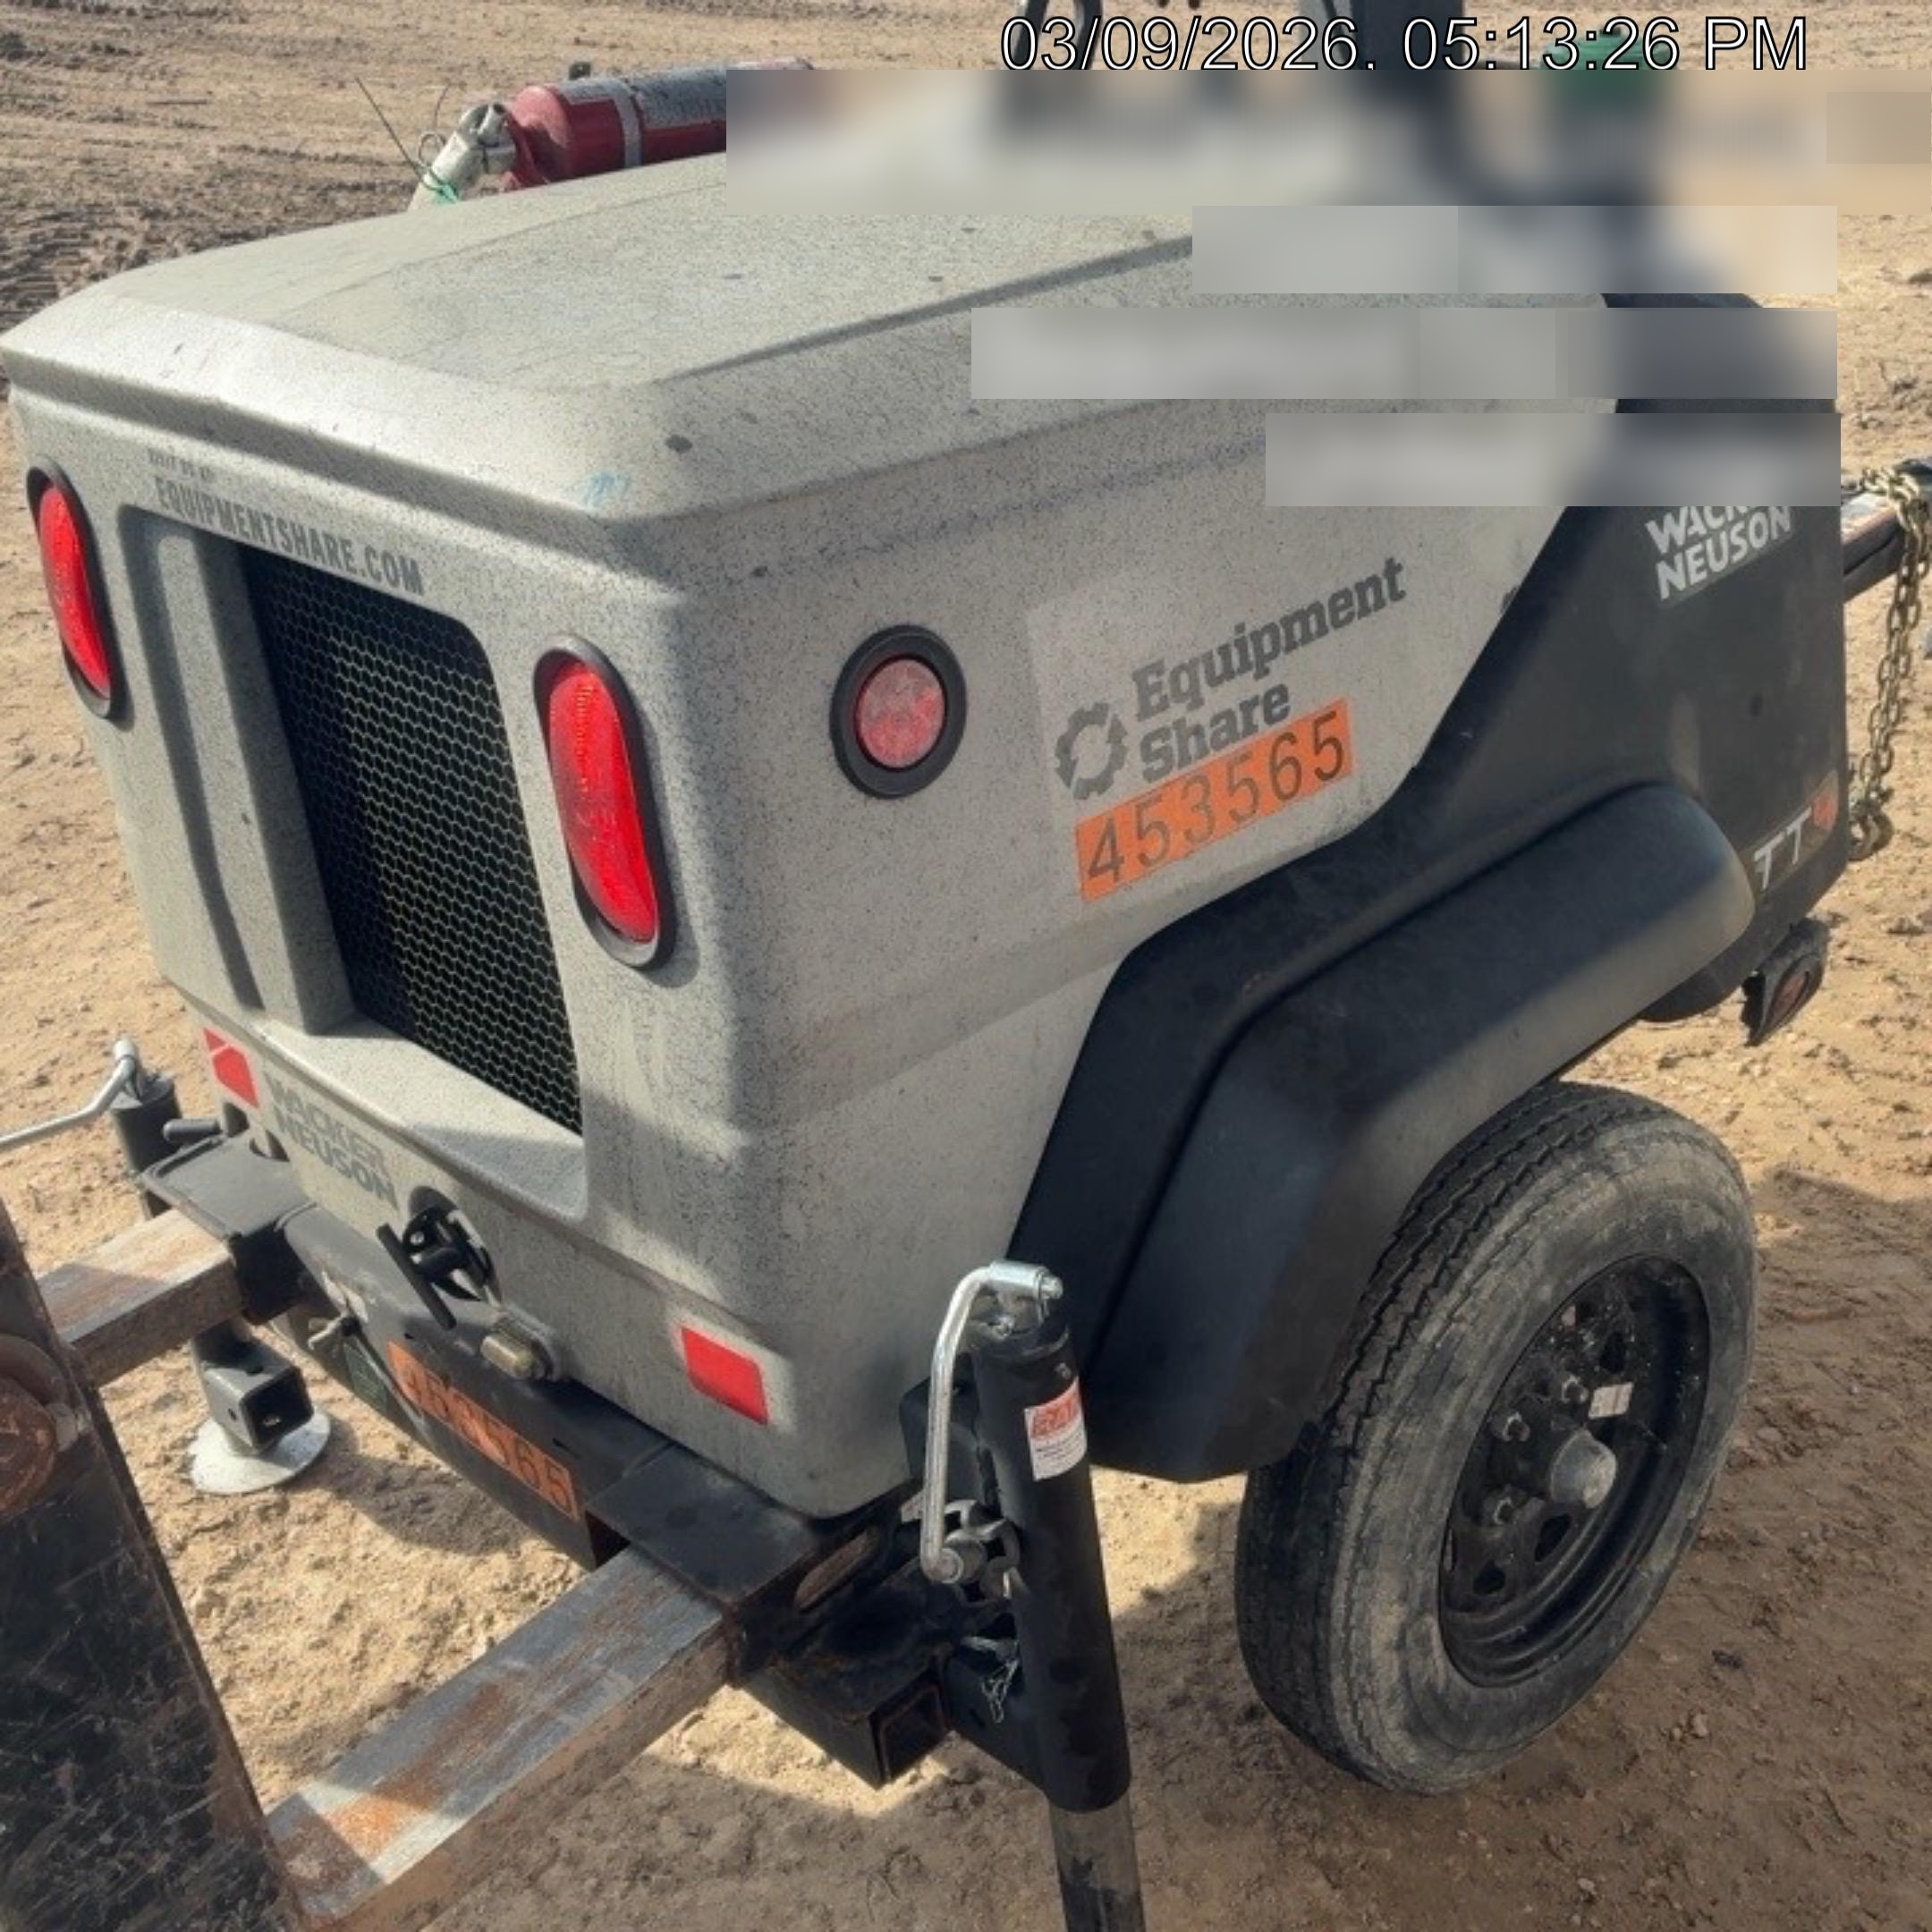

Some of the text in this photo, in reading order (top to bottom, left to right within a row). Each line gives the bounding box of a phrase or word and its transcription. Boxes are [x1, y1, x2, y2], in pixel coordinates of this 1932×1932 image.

[155, 477, 424, 596] EQUIPMENTSHARE.COM
[1657, 506, 1791, 601] NEUSON
[1131, 556, 1407, 722] Equipment
[1140, 682, 1291, 784] Share
[1088, 710, 1343, 884] 453565
[272, 1102, 400, 1211] NEUSON
